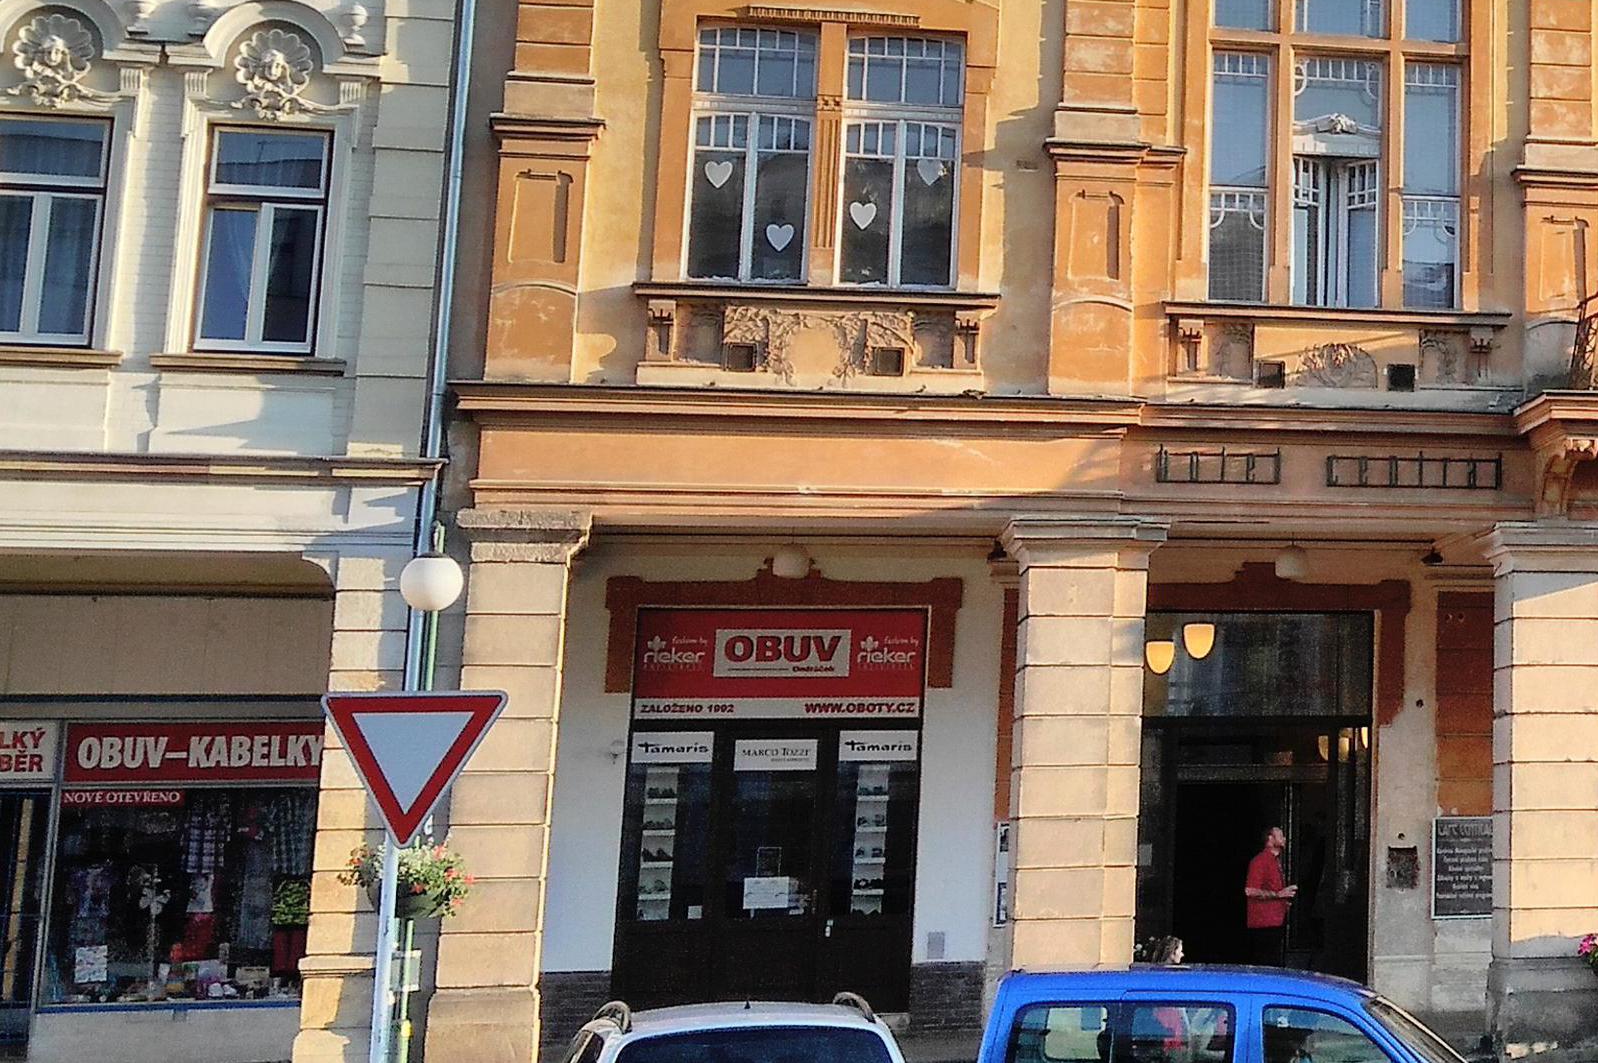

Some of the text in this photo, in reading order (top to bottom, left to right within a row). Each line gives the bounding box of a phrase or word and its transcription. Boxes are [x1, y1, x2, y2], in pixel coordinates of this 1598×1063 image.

[643, 647, 706, 663] rieker
[724, 635, 842, 663] OBUV
[857, 647, 917, 663] rieker
[640, 702, 735, 714] ZALOŽENO 1992
[804, 702, 915, 714] WWW.OBOTY.CZ
[637, 741, 709, 754] Tamaris
[844, 739, 913, 752] Tamaris
